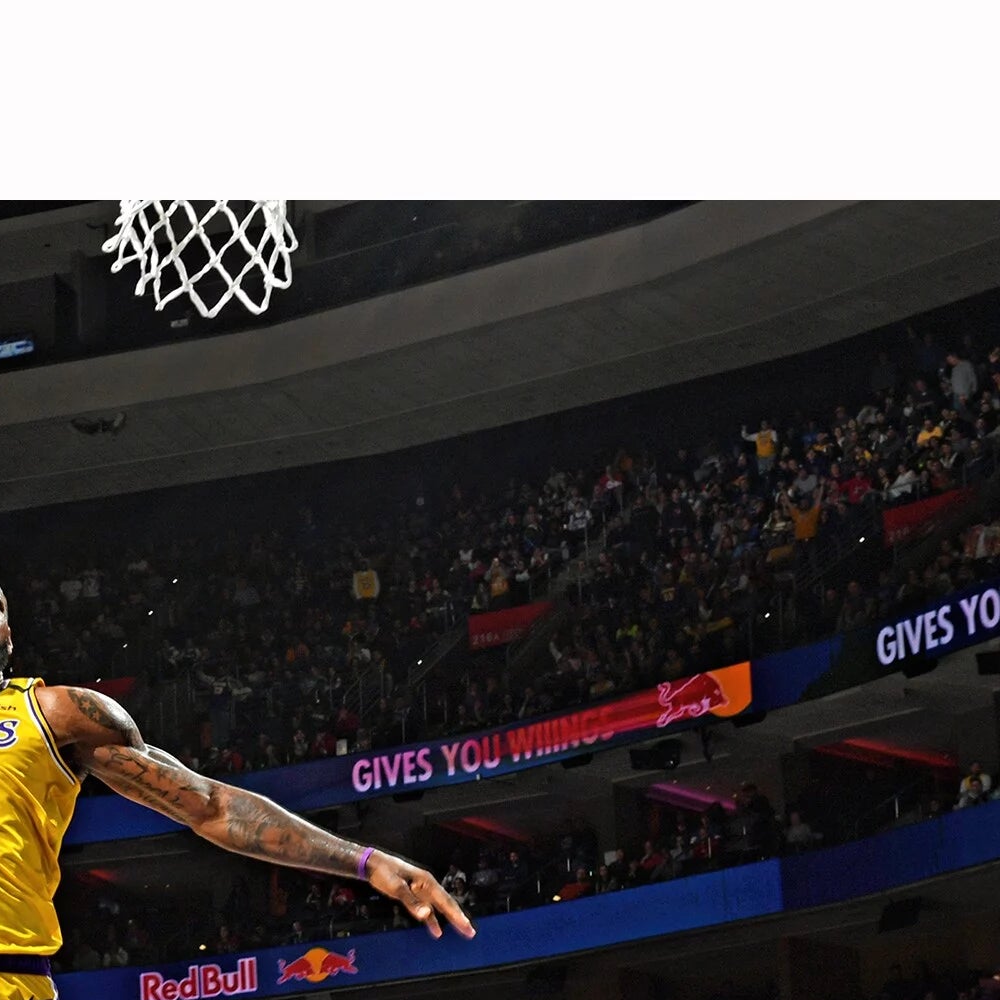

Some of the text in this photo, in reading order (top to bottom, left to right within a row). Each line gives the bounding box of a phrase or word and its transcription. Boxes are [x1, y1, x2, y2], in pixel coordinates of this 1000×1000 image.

[877, 604, 954, 666] GIVES
[352, 747, 433, 793] GIVES
[440, 728, 501, 777] YOU
